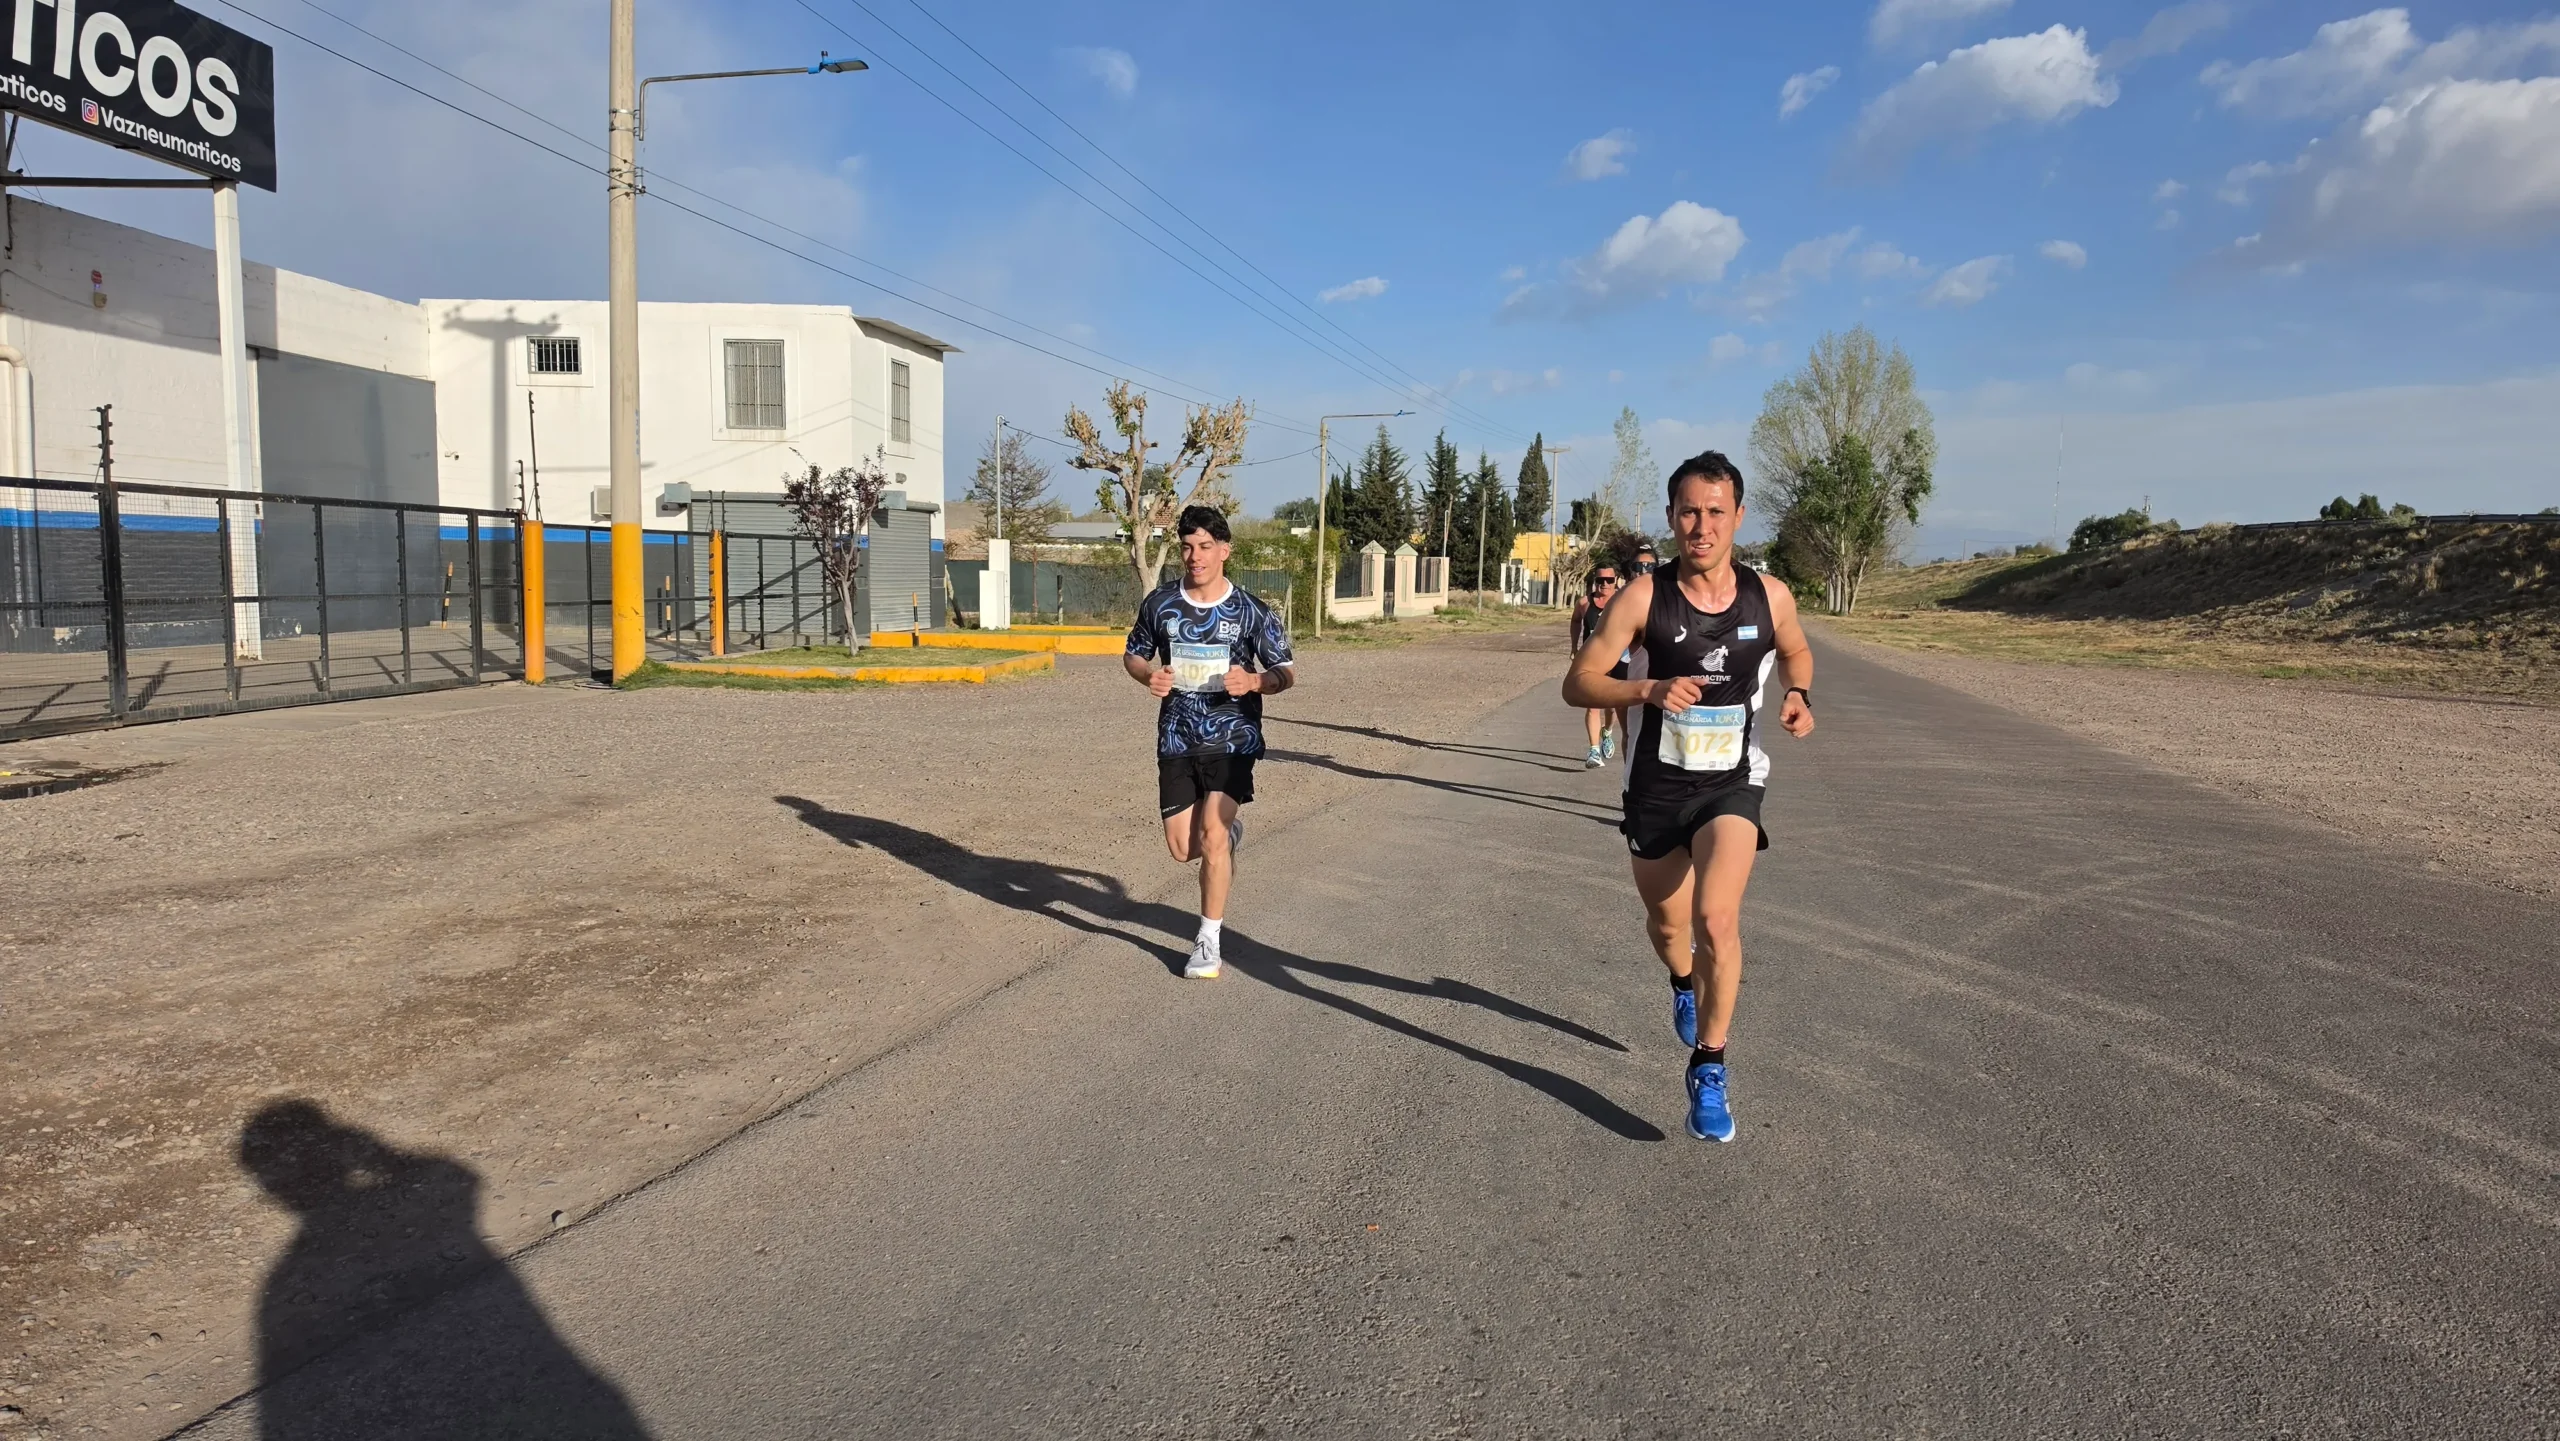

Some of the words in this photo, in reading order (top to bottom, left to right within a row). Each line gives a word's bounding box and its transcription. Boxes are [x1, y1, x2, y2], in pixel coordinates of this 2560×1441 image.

[0, 74, 66, 112] aticos
[101, 106, 242, 172] Vazneumaticos
[1679, 714, 1712, 723] BONARDA
[1674, 732, 1733, 754] 1072
